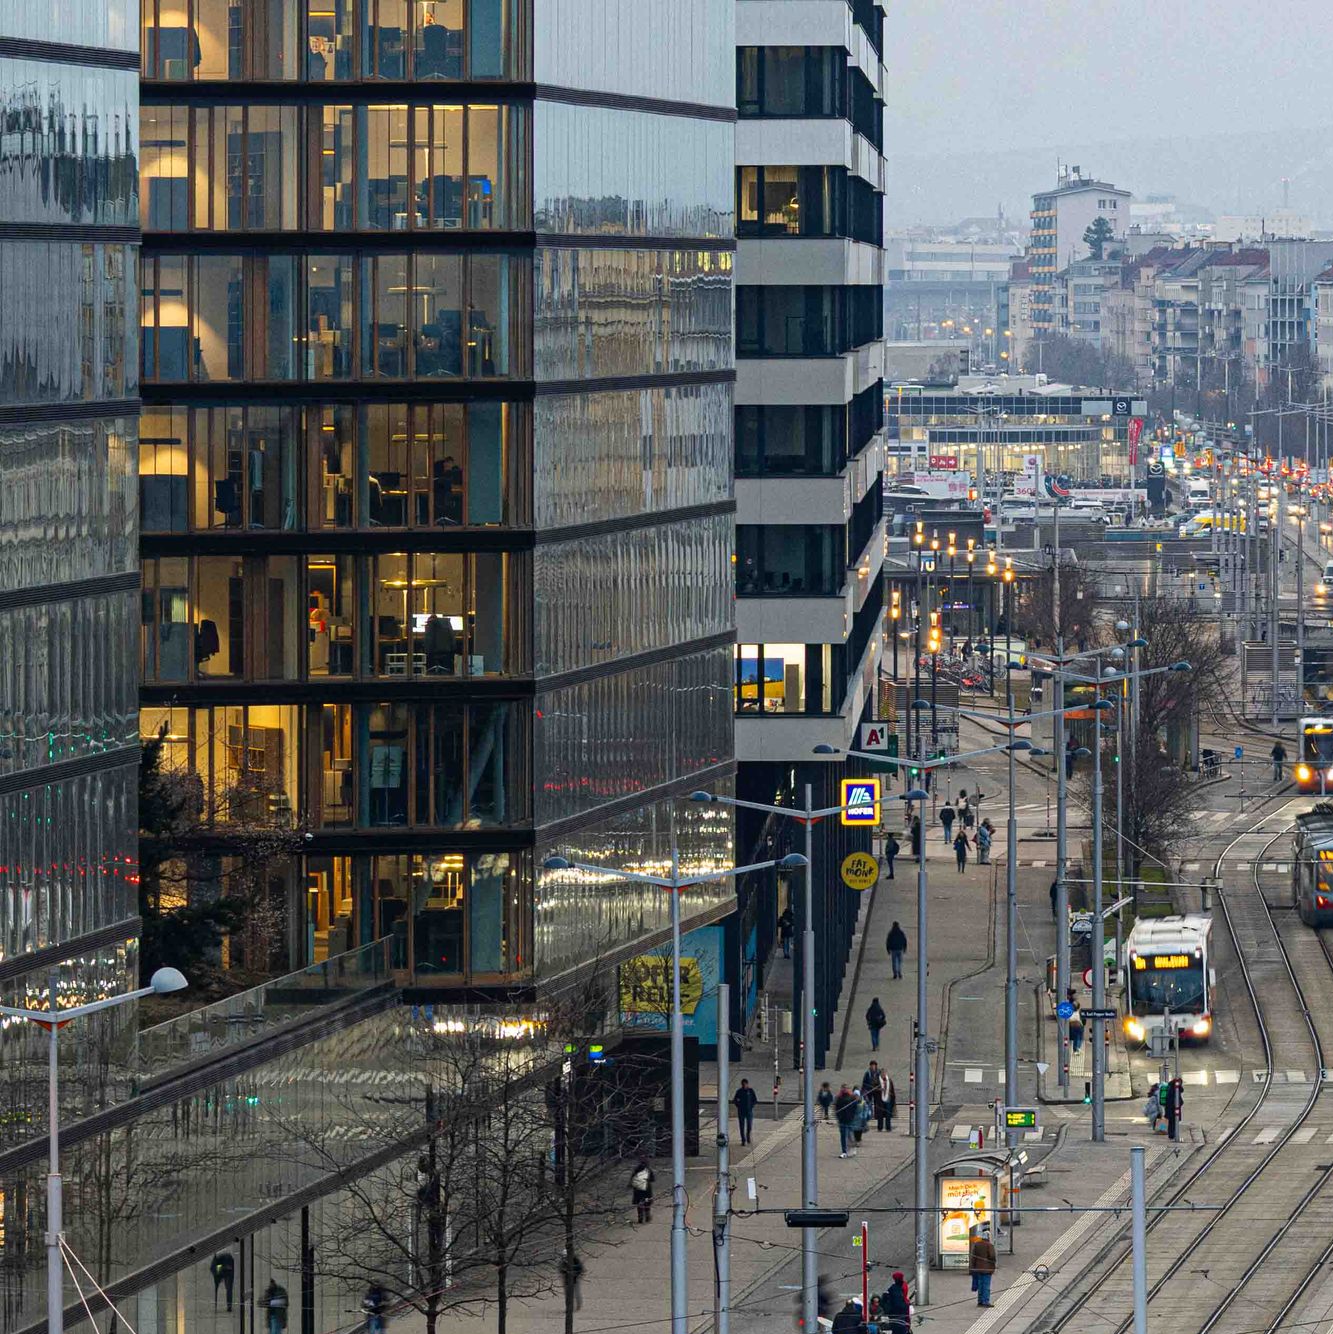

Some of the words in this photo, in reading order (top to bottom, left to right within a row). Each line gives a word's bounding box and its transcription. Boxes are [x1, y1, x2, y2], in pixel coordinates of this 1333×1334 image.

[866, 727, 884, 746] A1
[848, 807, 873, 815] HOFER
[852, 859, 868, 869] FAT
